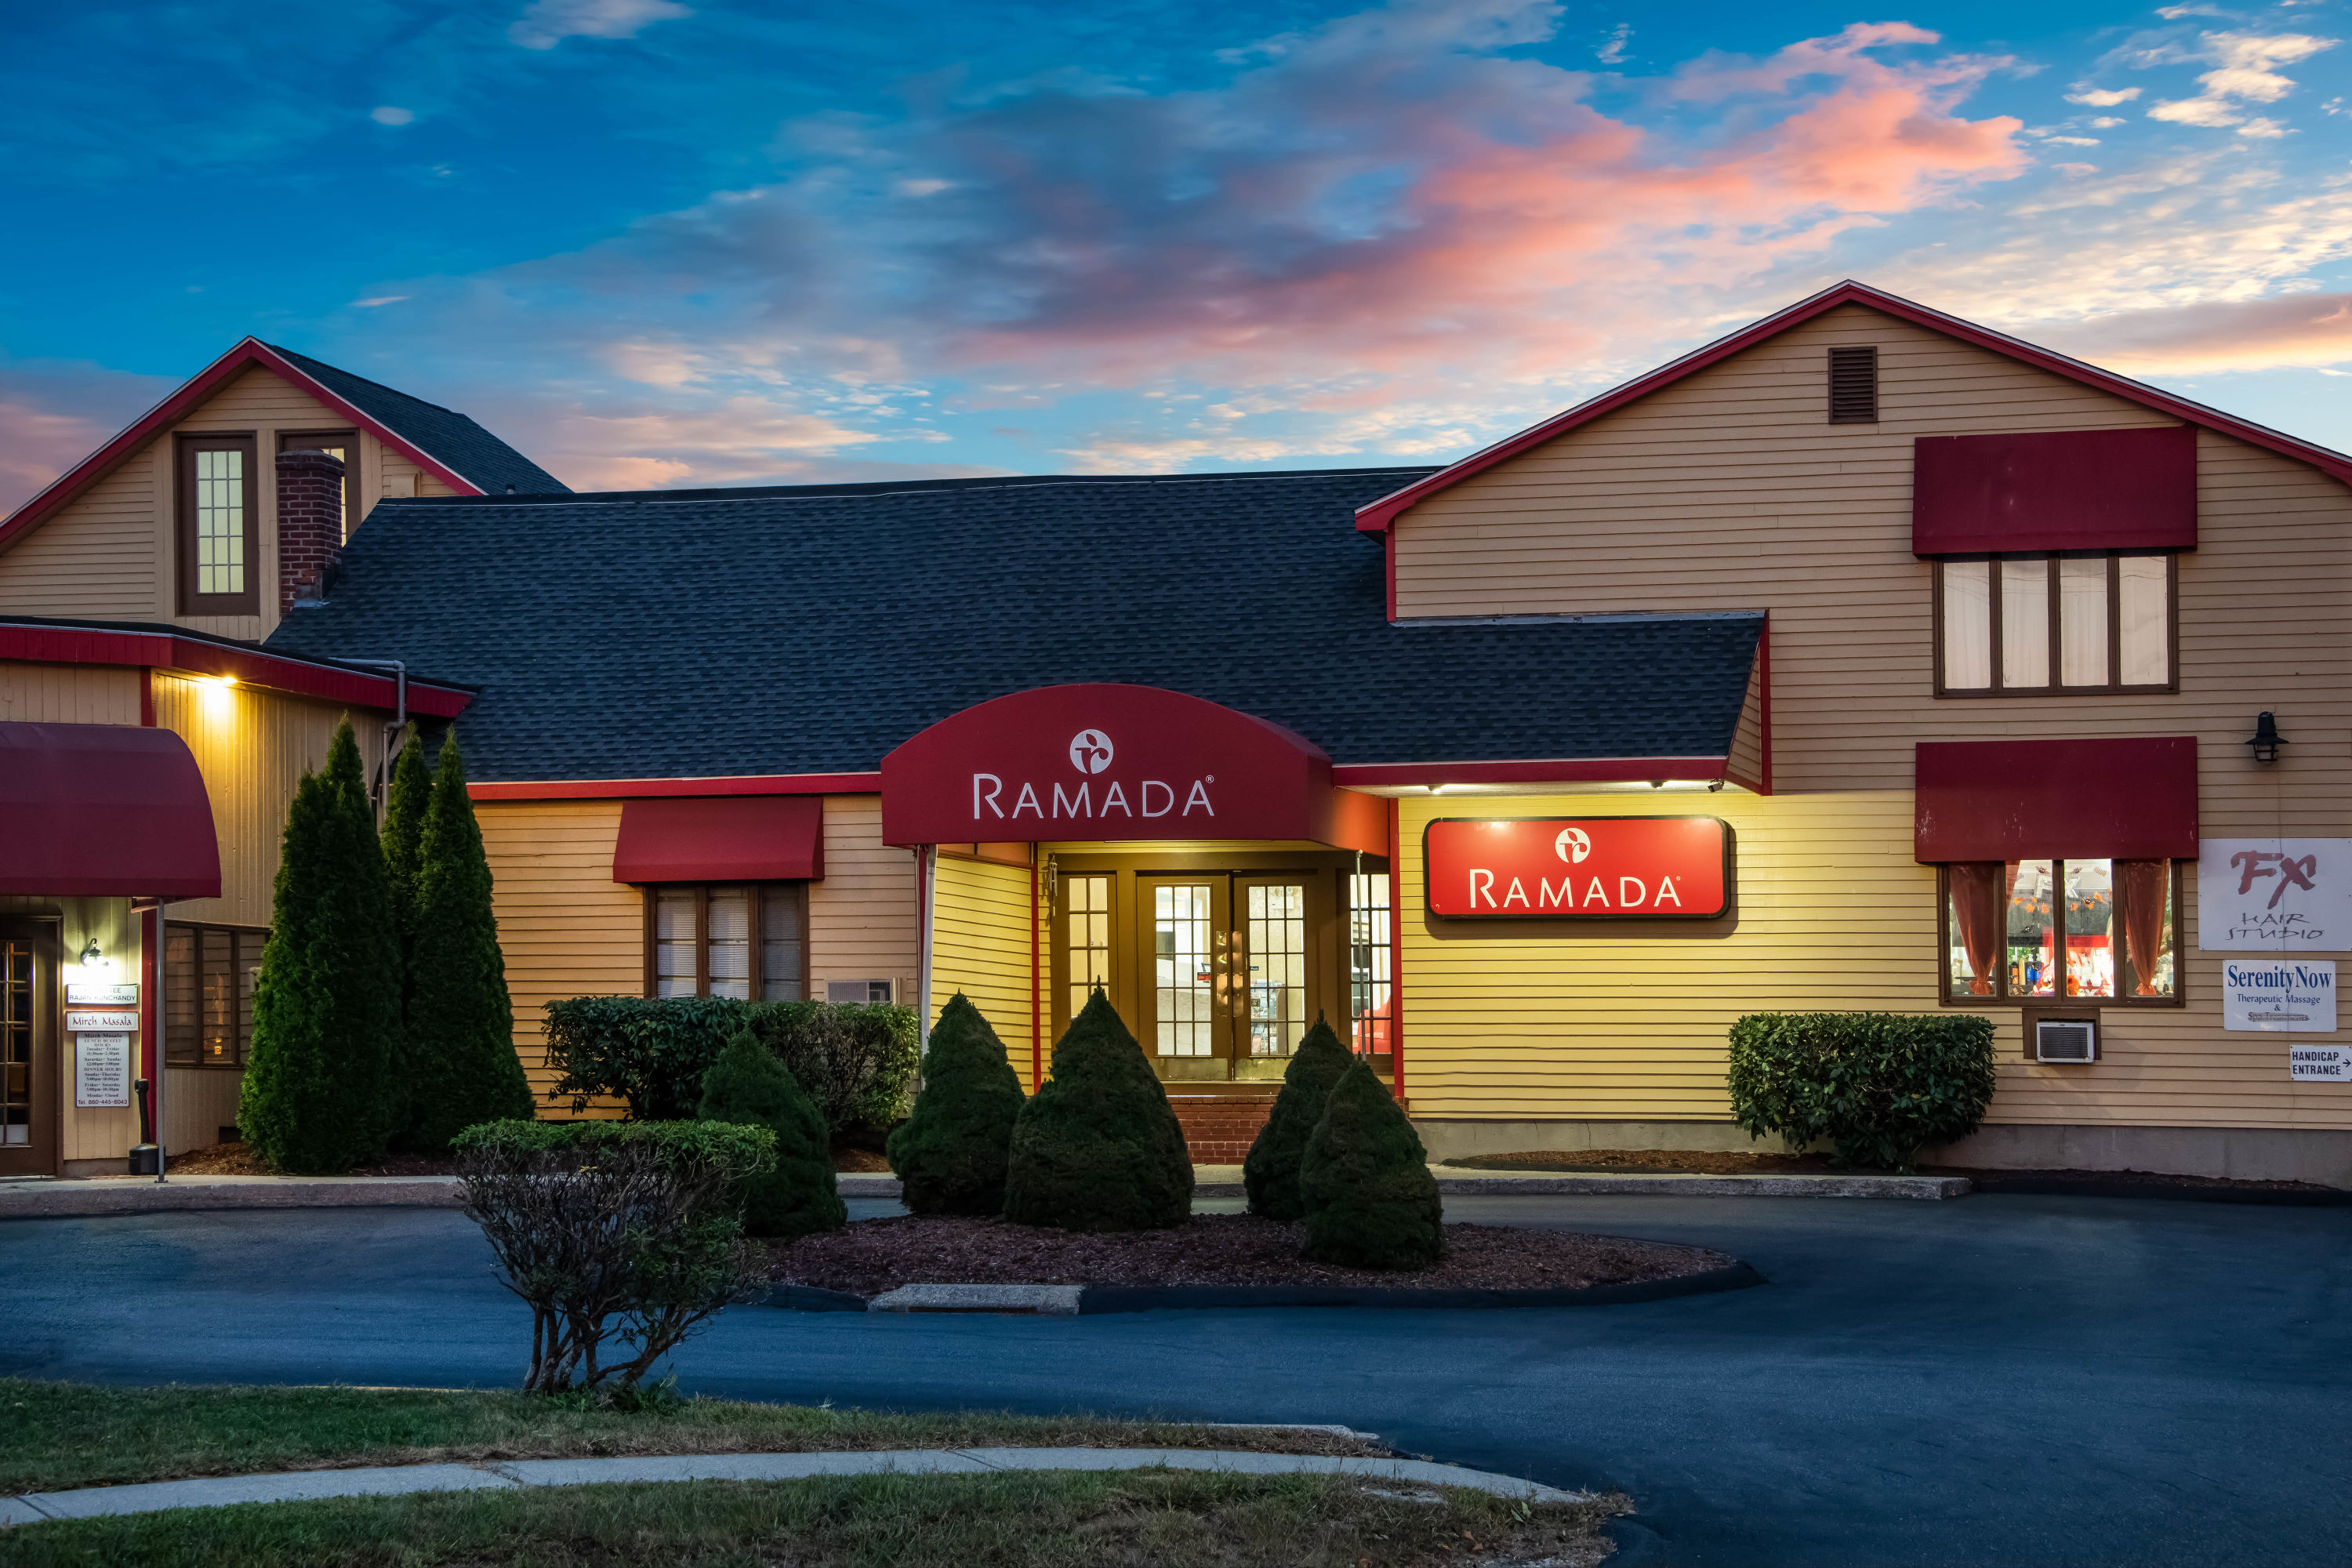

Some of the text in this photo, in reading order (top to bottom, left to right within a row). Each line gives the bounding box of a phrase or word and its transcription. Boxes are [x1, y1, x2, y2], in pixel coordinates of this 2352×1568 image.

[973, 773, 1215, 819] RAMADA
[1469, 869, 1682, 909] RAMADA
[2241, 913, 2310, 927] HAIR
[2225, 927, 2325, 940] STUDIO
[2237, 993, 2321, 1006] Therapeutic Massage
[72, 1015, 132, 1025] Mirch Masala
[2292, 1051, 2339, 1062] HANDICAP
[2292, 1065, 2342, 1075] ENTRANCE
